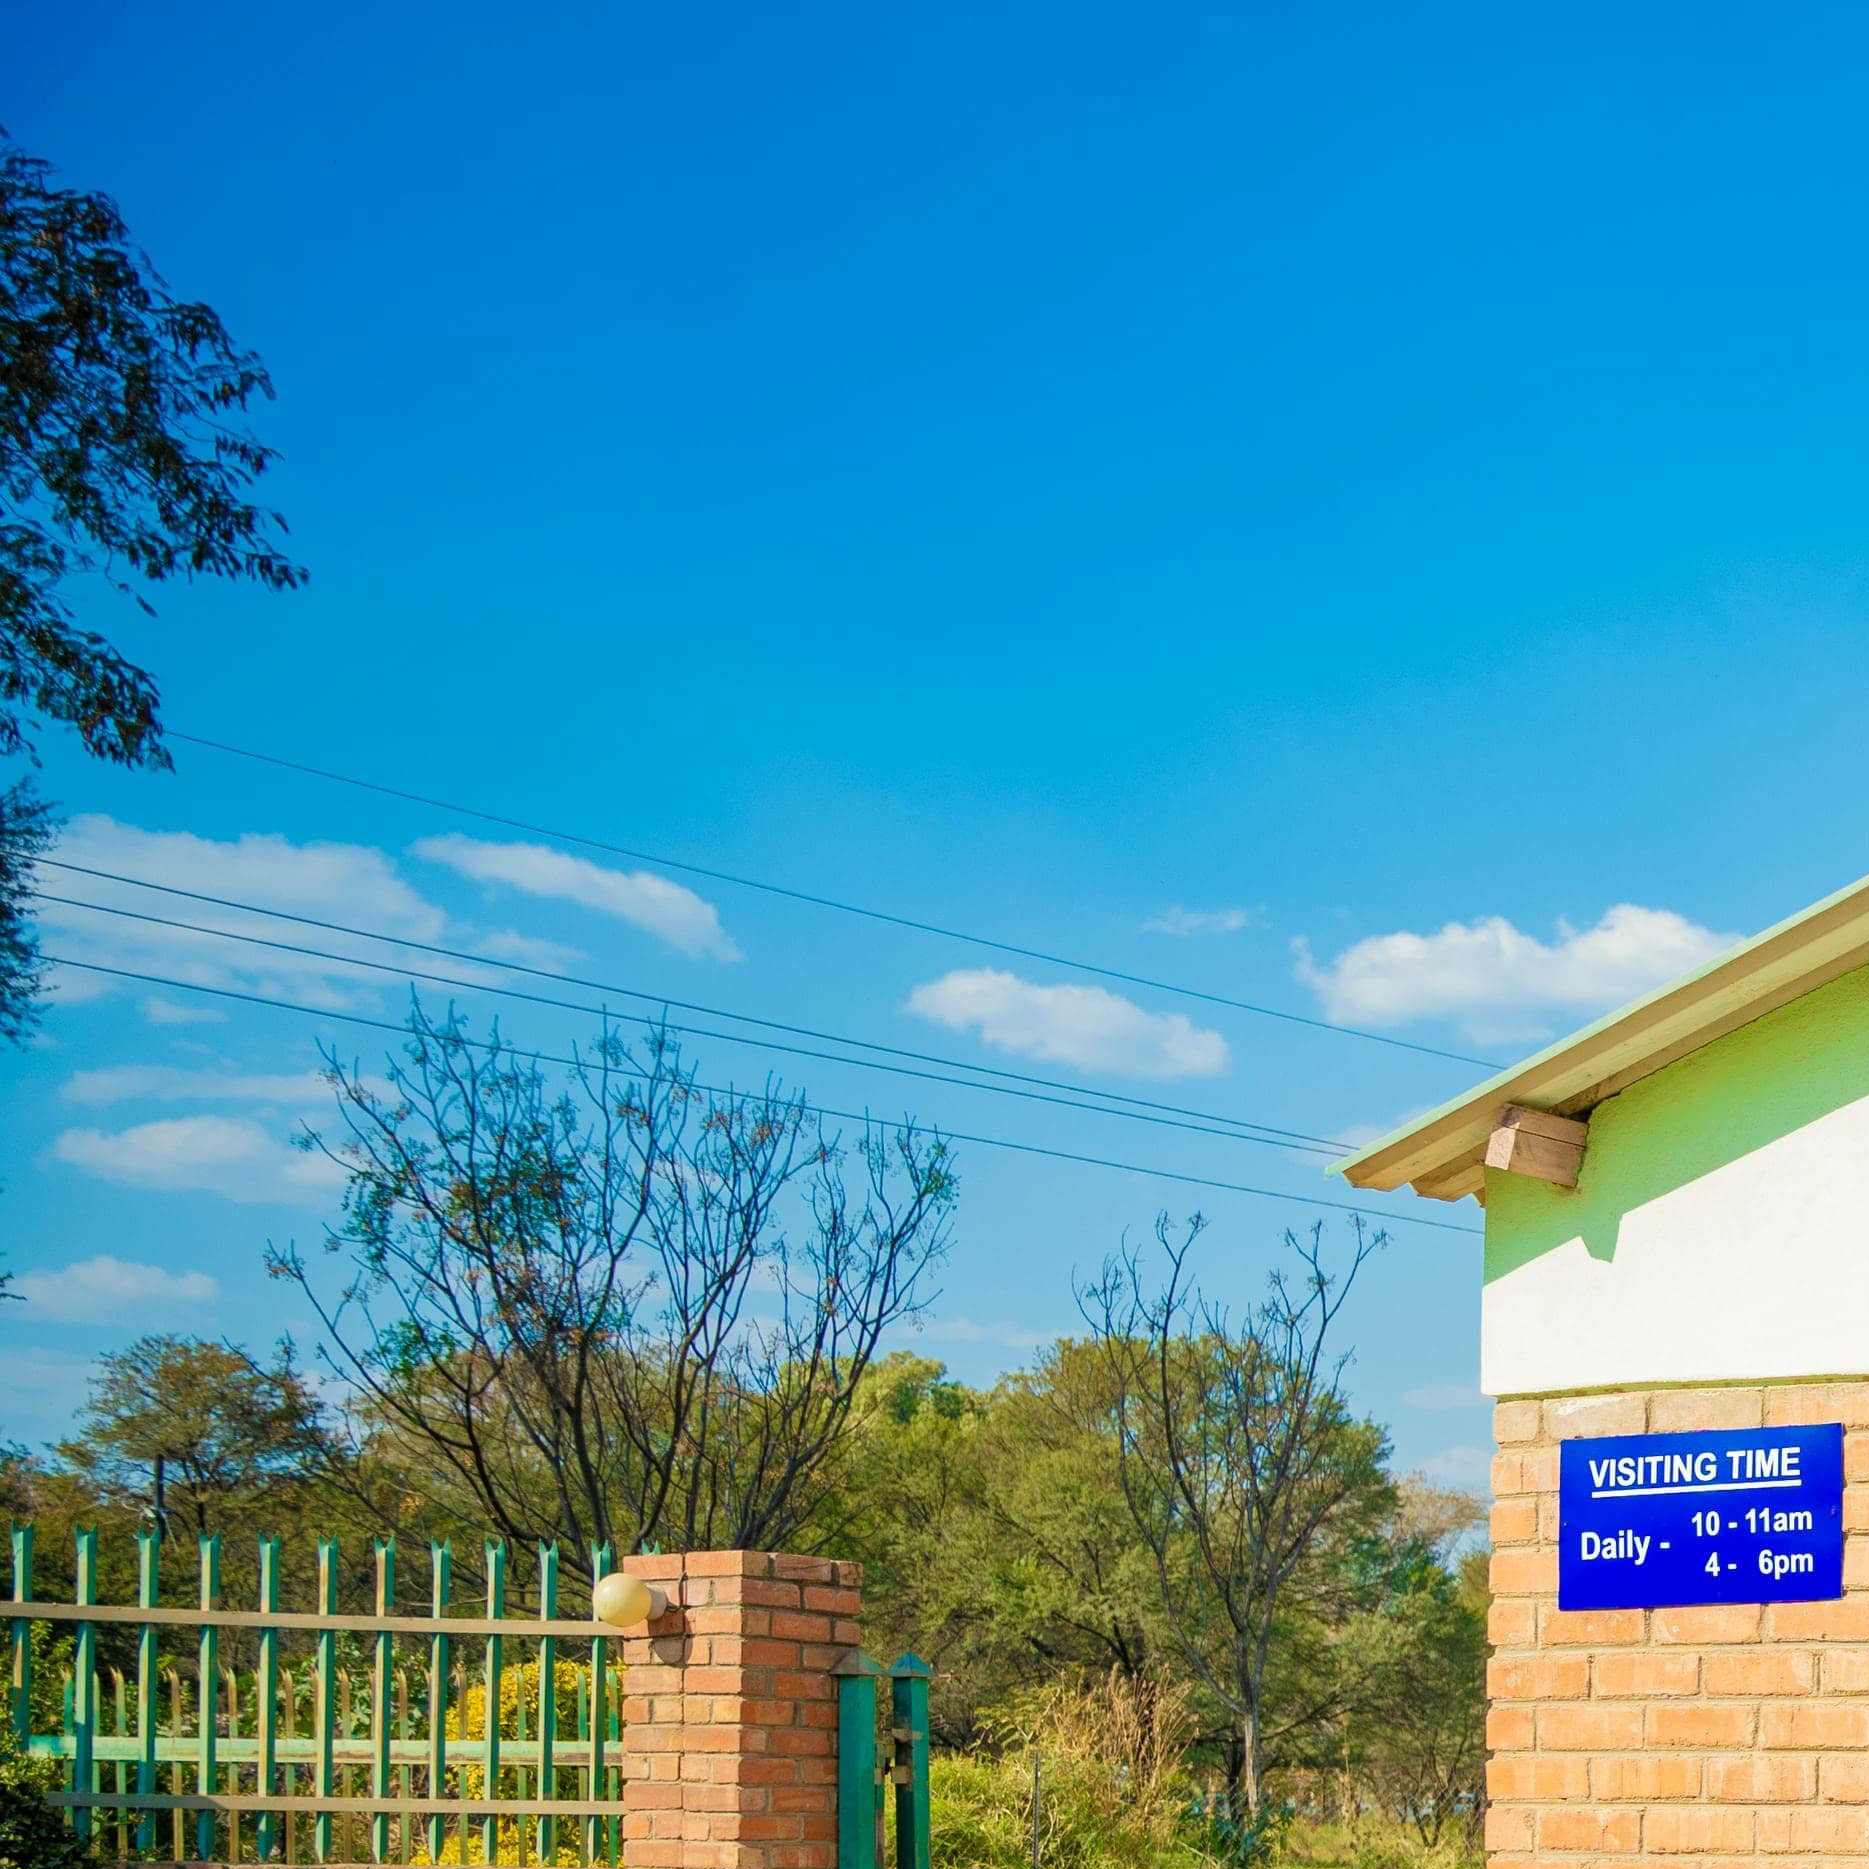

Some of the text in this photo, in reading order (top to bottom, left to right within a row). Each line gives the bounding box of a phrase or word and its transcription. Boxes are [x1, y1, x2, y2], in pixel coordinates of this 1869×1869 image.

[1588, 1446, 1802, 1488] VISITING TIME
[1691, 1510, 1721, 1537] 10
[1745, 1507, 1813, 1534] 11am
[1580, 1529, 1651, 1566] Daily
[1704, 1551, 1721, 1577] 4
[1758, 1549, 1814, 1580] 6pm
